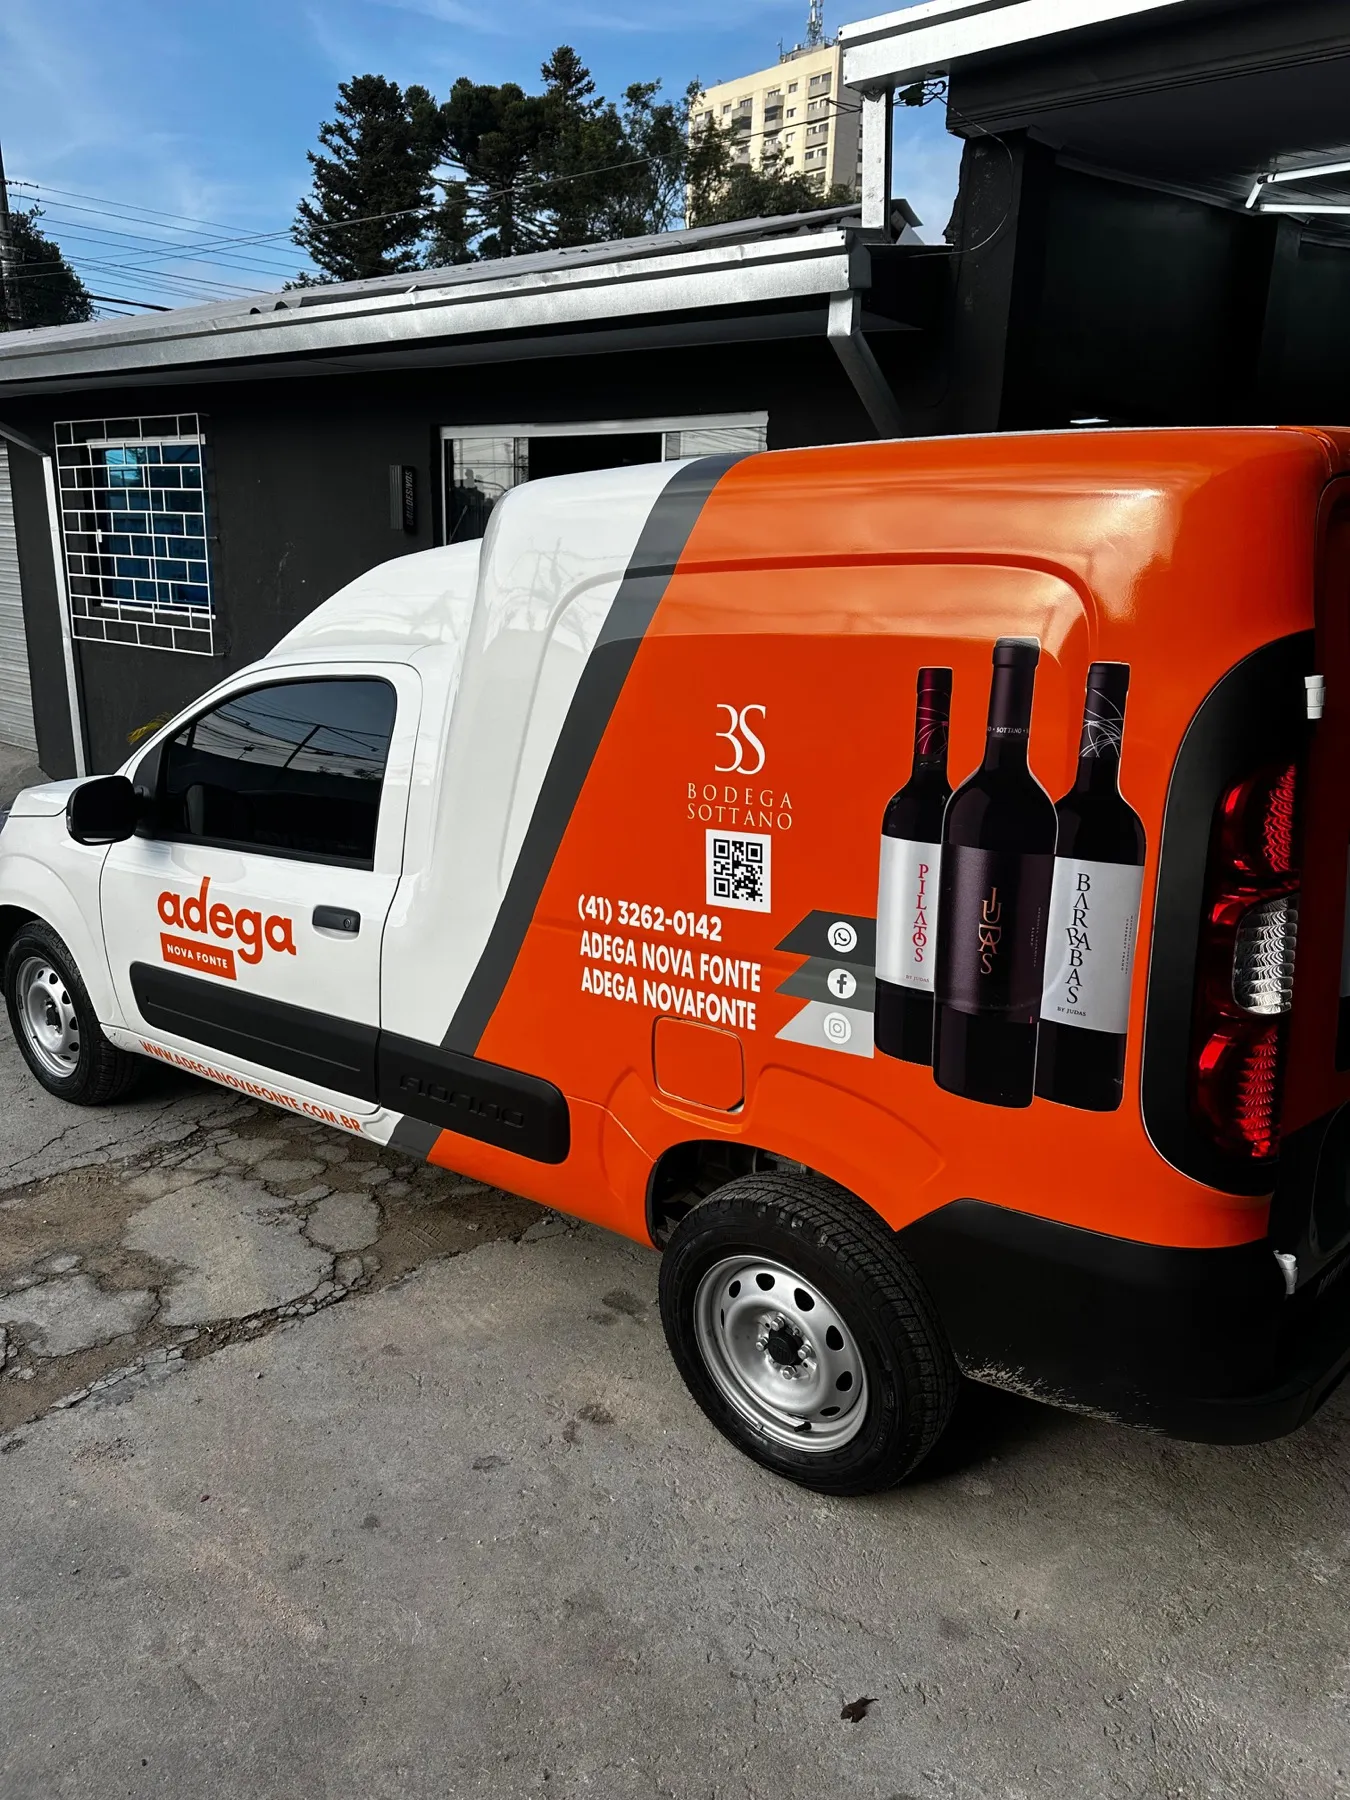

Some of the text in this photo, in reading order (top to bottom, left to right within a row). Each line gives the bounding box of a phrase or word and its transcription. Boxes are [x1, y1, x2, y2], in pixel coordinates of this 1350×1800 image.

[687, 782, 793, 810] BODEGA
[687, 802, 793, 831] SOTTANO
[157, 876, 297, 965] adega
[577, 893, 723, 942] (41) 3262-0142
[912, 863, 928, 963] PILATOS
[1065, 872, 1092, 1005] BARRABAS
[166, 943, 228, 969] NOVA FONTE
[579, 930, 762, 993] ADEGA NOVA FONTE
[580, 966, 757, 1031] ADEGA NOVAFONTE
[1066, 1008, 1087, 1017] JUDAS
[138, 1039, 364, 1134] WWW.ADEGANOVAFONTE.COM.BR
